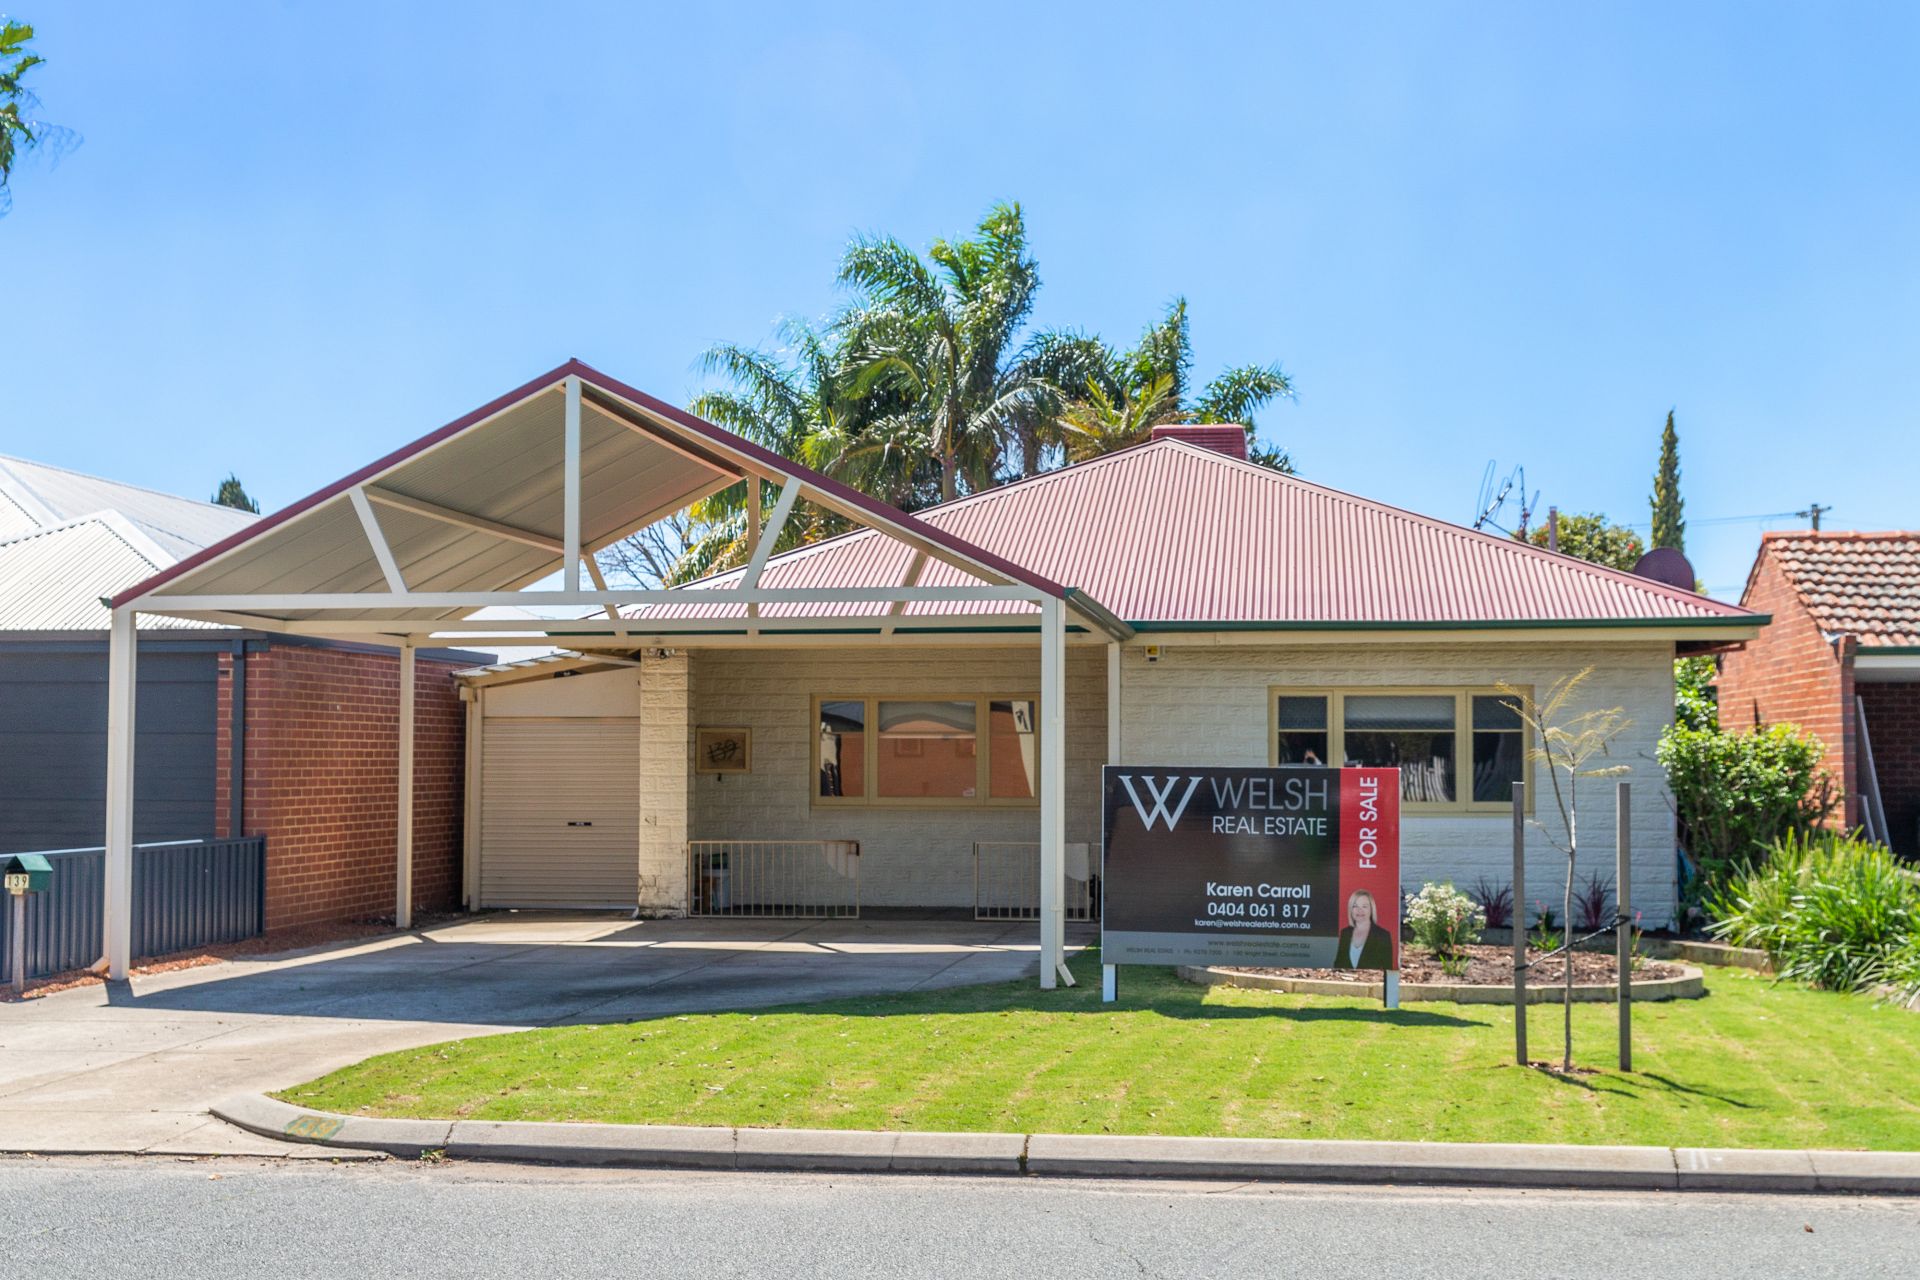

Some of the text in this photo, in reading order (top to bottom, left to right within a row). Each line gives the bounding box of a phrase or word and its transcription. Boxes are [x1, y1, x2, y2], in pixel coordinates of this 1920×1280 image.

[1211, 777, 1328, 811] WELSH
[1212, 816, 1327, 836] REAL ESTATE
[1359, 777, 1379, 869] FOR SALE
[8, 875, 27, 887] 139
[1207, 882, 1311, 899] Karen Carroll
[1207, 902, 1311, 918] 0404 061 817
[1194, 918, 1311, 930] karen@welshrealestate.com.au
